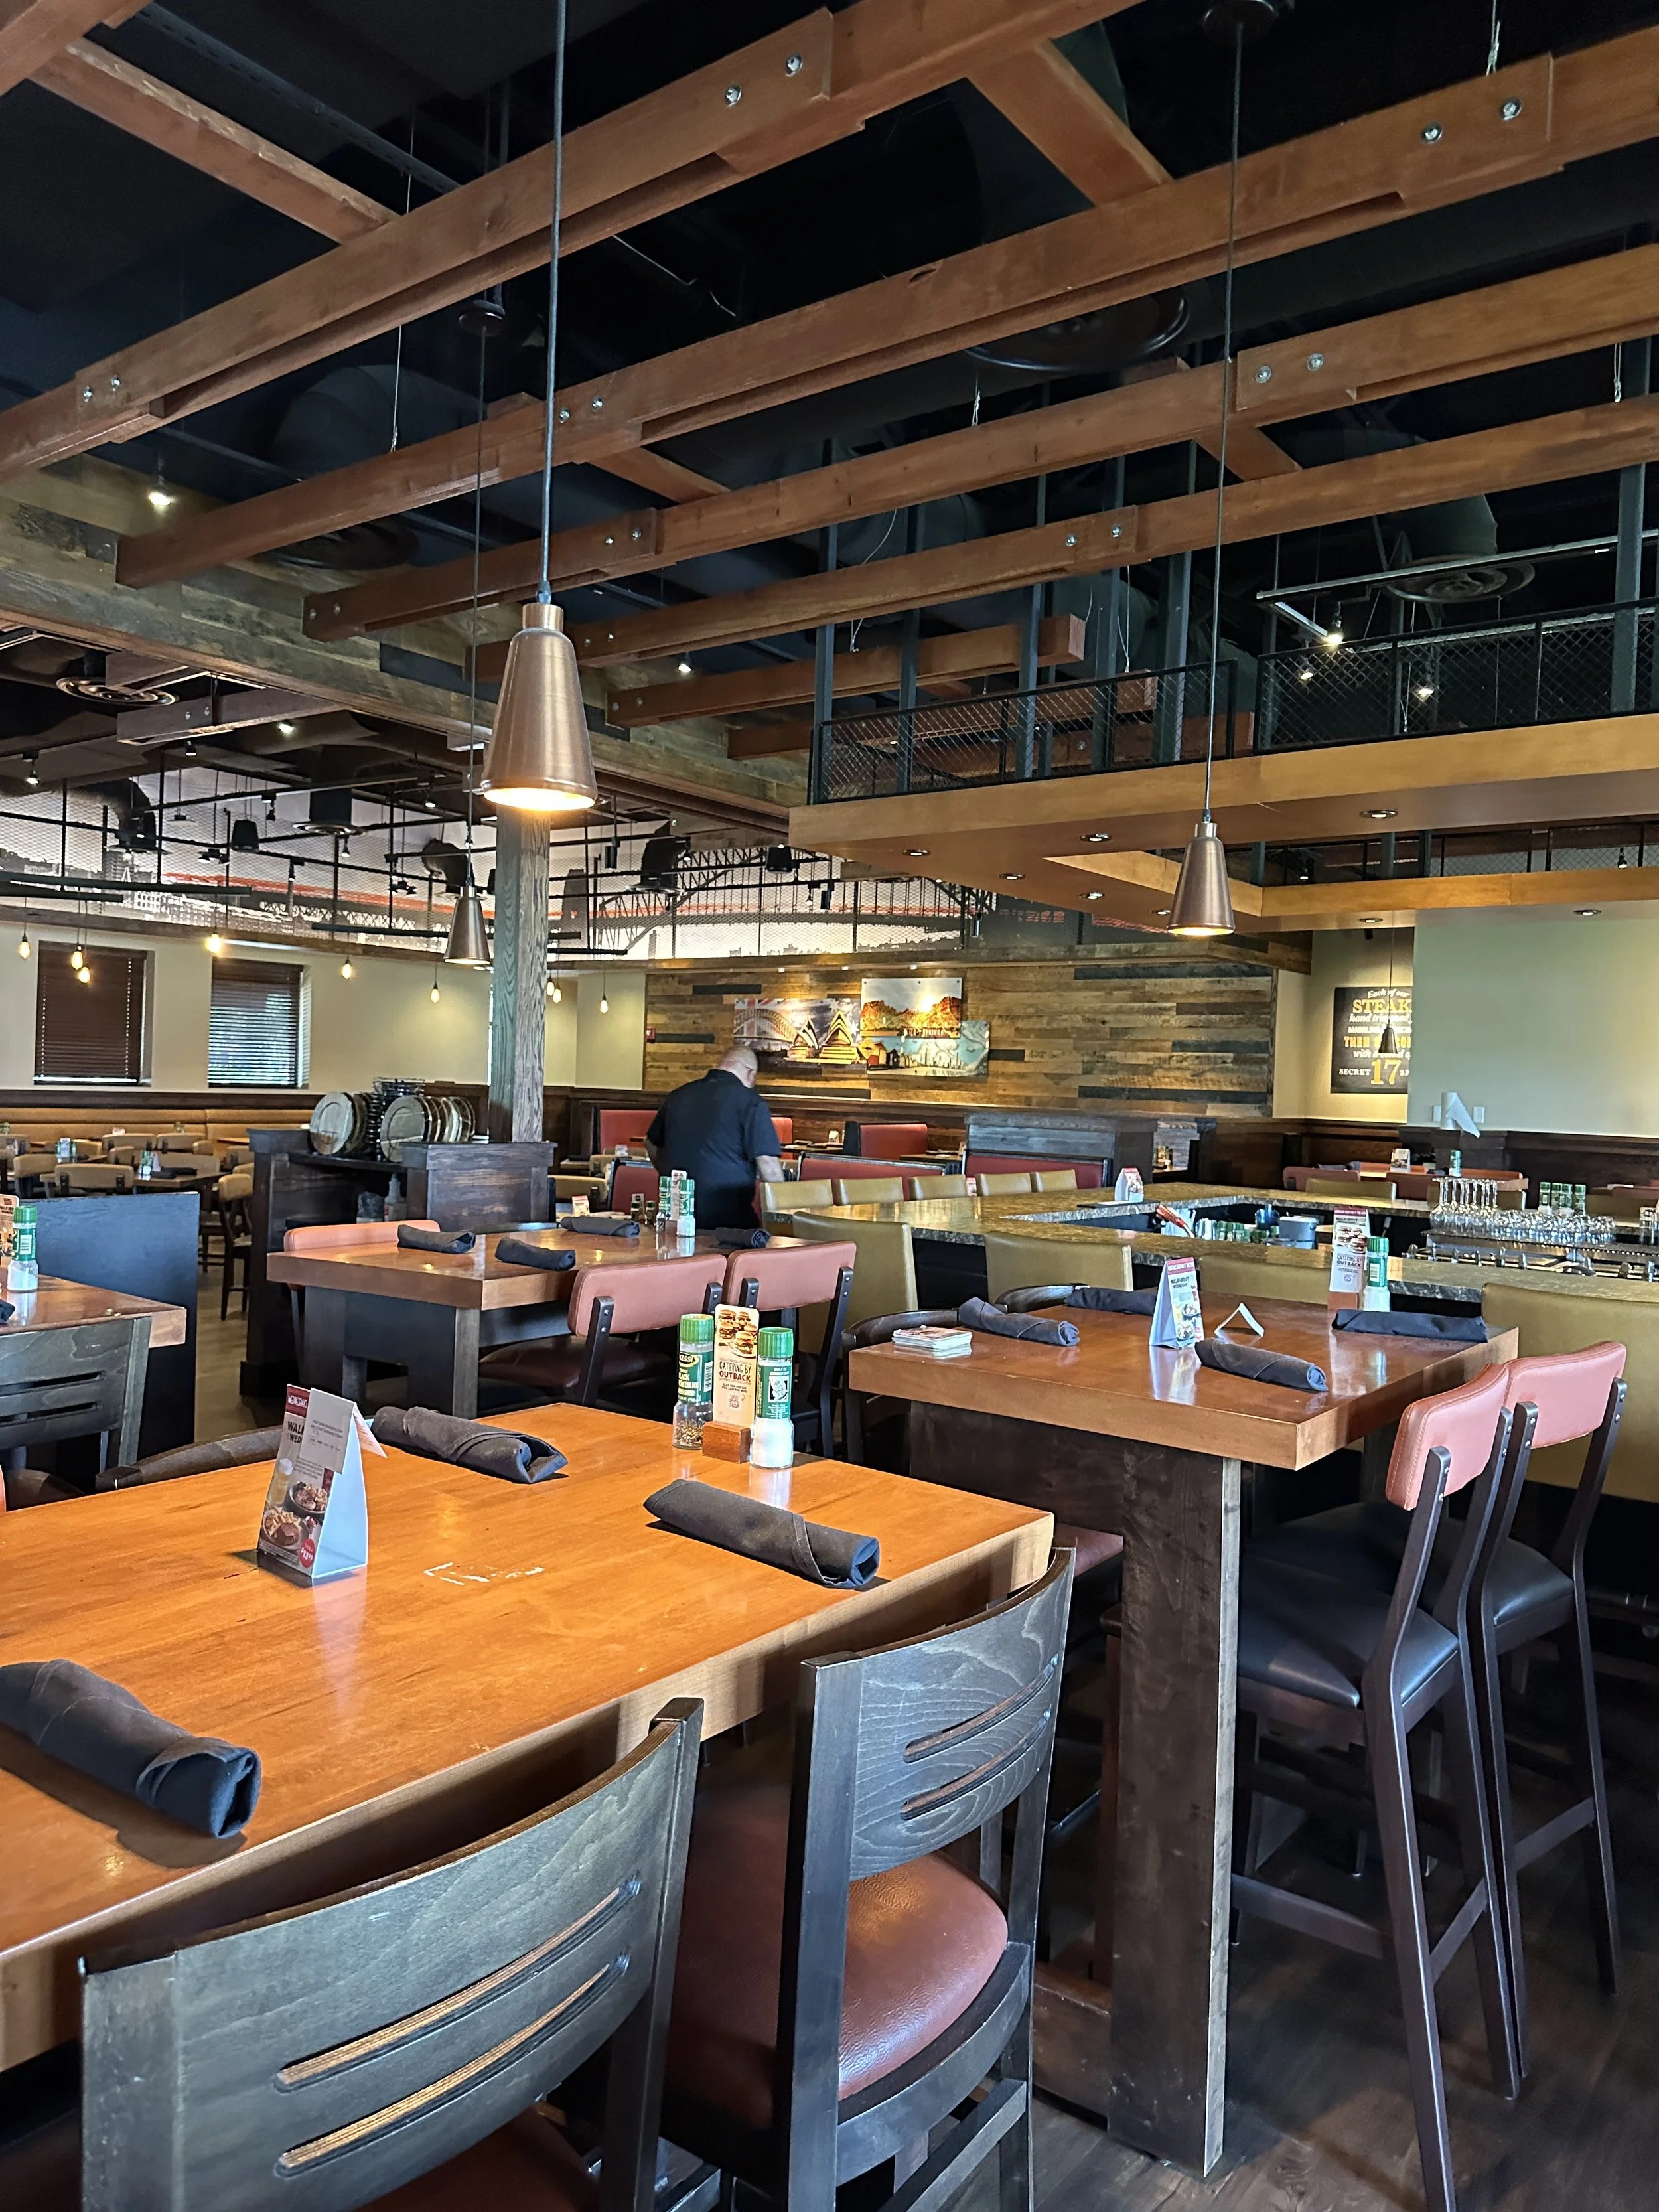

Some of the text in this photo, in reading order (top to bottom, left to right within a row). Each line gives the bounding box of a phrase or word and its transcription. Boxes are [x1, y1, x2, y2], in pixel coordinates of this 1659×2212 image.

[1367, 988, 1386, 999] Each
[1348, 1013, 1372, 1023] hand
[1344, 1036, 1370, 1048] THEN
[1353, 1049, 1372, 1058] with
[1370, 1059, 1402, 1085] 17
[719, 1361, 752, 1374] CATERING BY
[719, 1370, 751, 1382] OUTBACK
